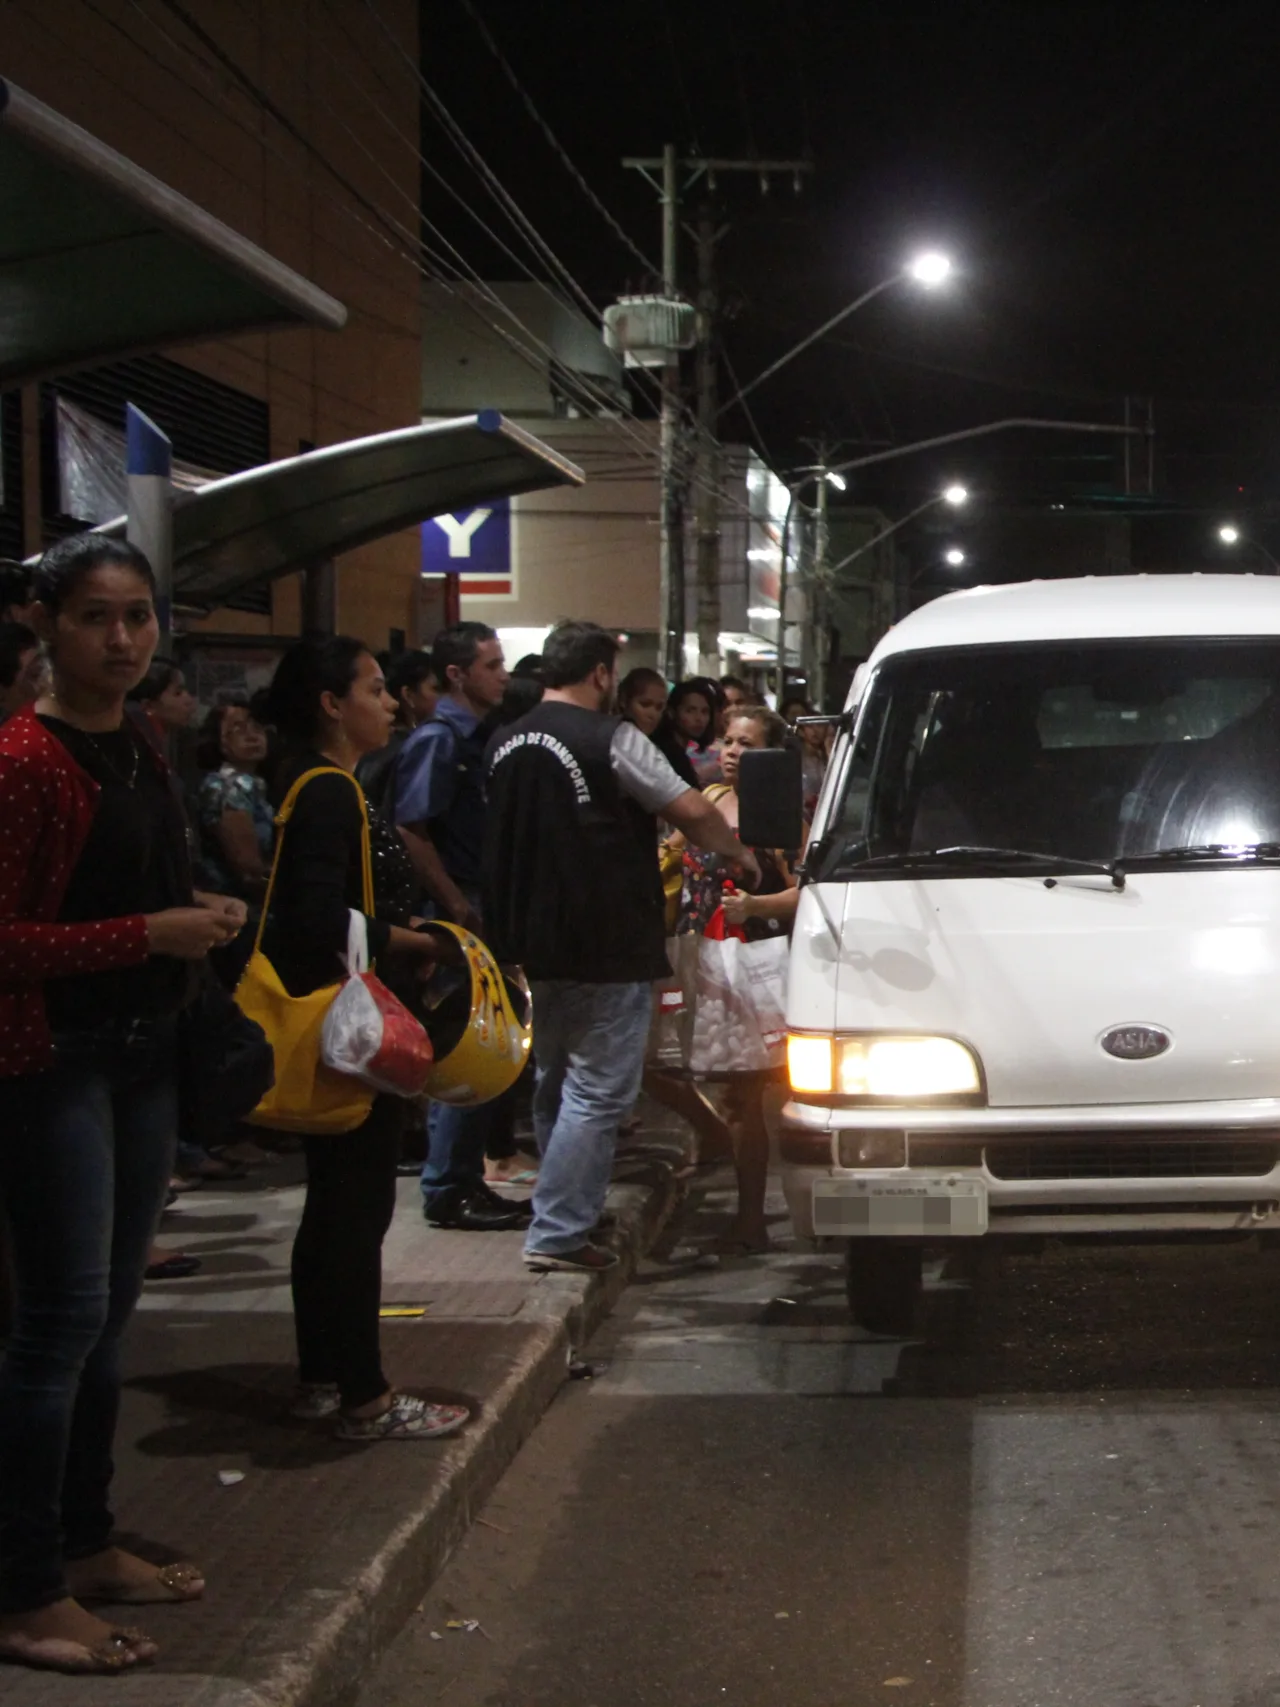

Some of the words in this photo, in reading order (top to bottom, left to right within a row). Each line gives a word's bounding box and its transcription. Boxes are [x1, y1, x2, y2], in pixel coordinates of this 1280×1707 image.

[432, 508, 493, 558] Y
[526, 732, 542, 745] DE
[541, 733, 591, 803] TRANSPORTE
[1111, 1032, 1157, 1049] ASIA
